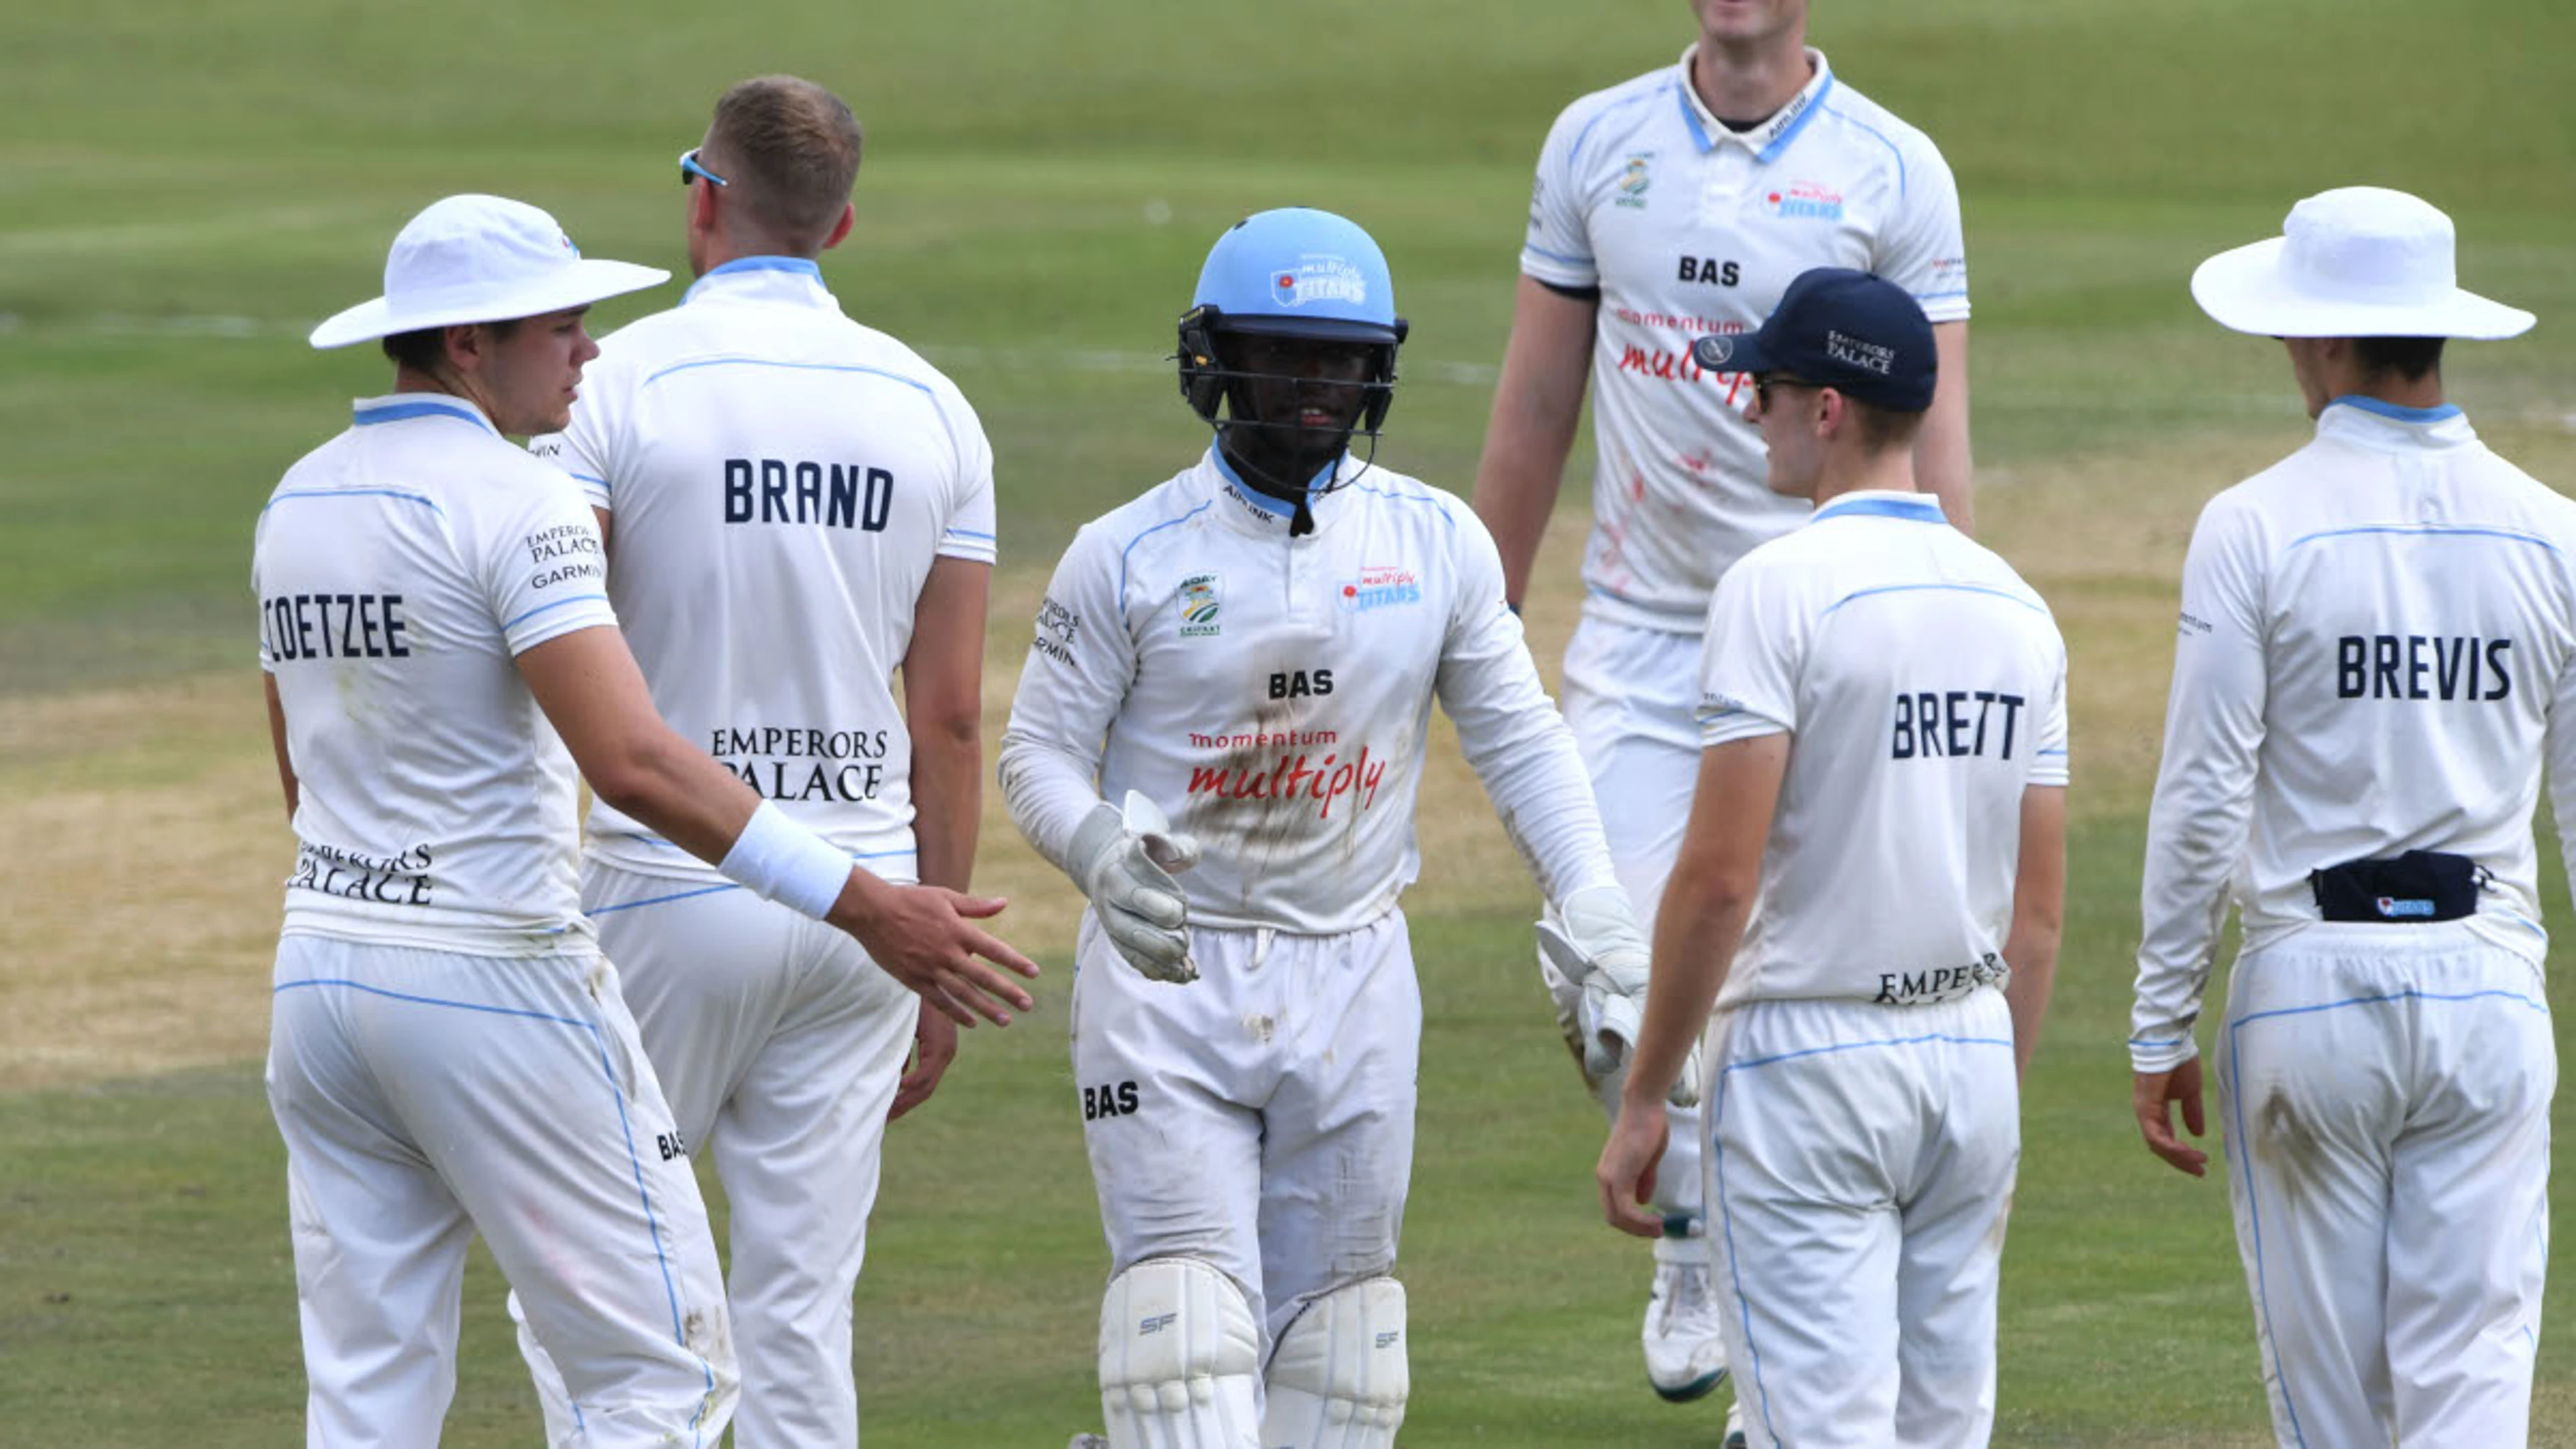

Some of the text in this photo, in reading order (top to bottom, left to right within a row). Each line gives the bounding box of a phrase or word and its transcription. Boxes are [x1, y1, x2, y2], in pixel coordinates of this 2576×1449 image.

[1679, 256, 1740, 287] BAS
[1617, 307, 1744, 335] momentum
[1828, 341, 1890, 374] PALACE
[725, 459, 894, 532] BRAND
[2338, 635, 2512, 701] BREVIS
[1269, 669, 1334, 700] BAS
[1189, 730, 1338, 749] momentum
[1892, 691, 2025, 760] BRETT
[712, 727, 888, 759] EMPERORS
[1187, 745, 1386, 819] multiply
[1084, 1080, 1139, 1122] BAS
[1139, 1313, 1177, 1336] SF
[1375, 1331, 1399, 1349] SF
